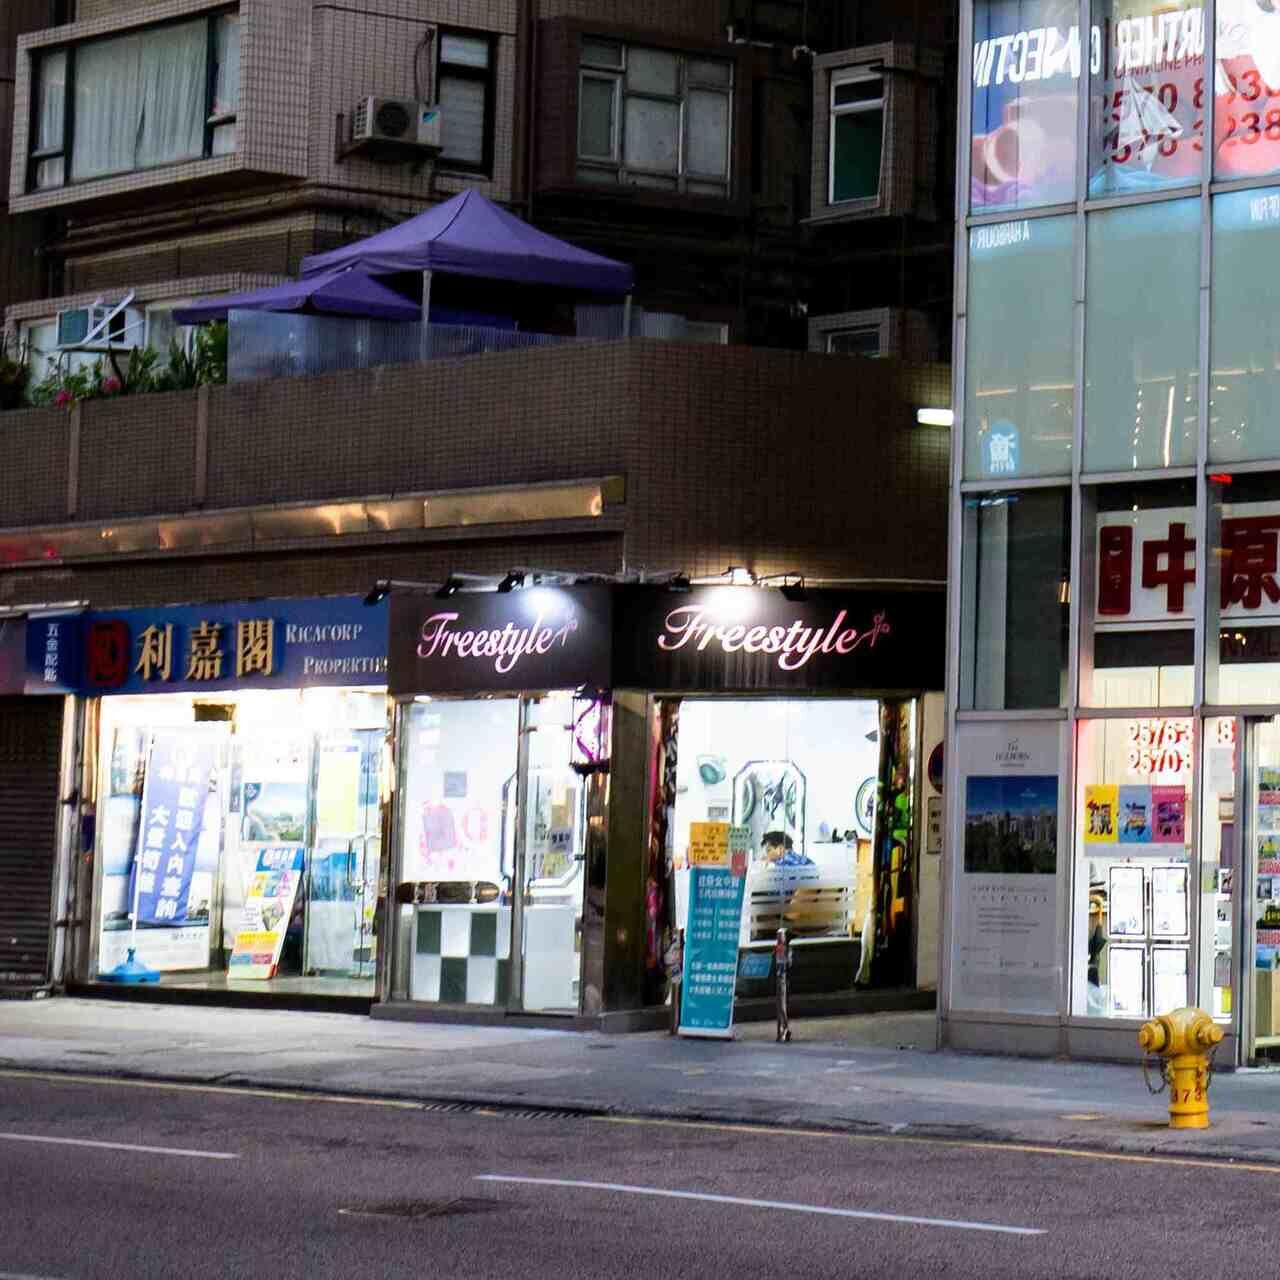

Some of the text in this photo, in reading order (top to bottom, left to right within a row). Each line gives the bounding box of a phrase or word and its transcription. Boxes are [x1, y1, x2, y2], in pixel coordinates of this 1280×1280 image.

[135, 618, 275, 681] 利嘉閣
[285, 623, 363, 644] RICACORP
[416, 610, 553, 673] Freestyle
[658, 605, 858, 671] Freestyle
